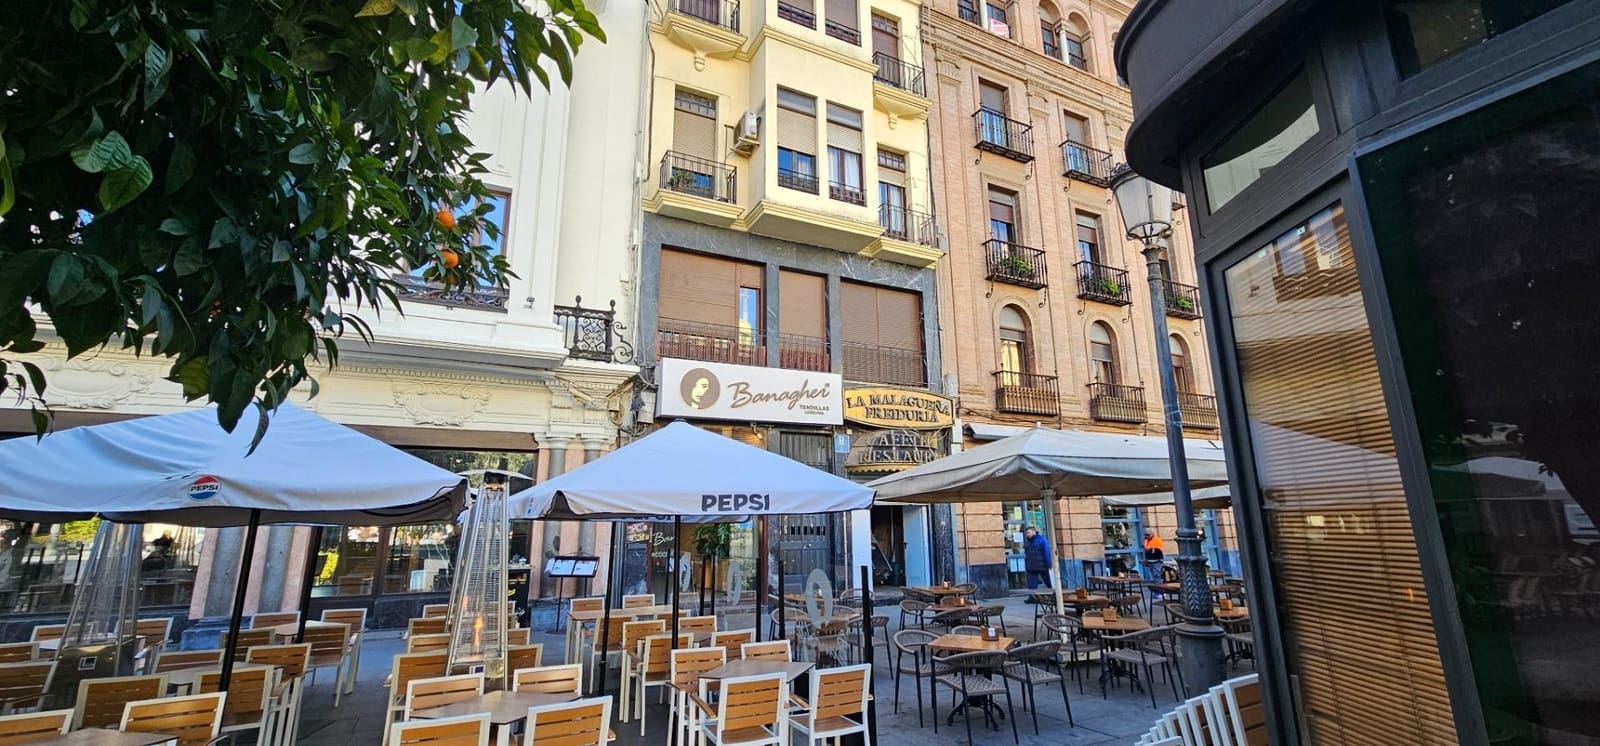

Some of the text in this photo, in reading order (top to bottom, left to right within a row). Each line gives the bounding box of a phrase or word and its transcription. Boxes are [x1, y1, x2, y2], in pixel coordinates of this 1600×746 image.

[728, 379, 829, 410] Banagher
[846, 396, 866, 408] LA
[191, 484, 219, 492] PEPSI
[701, 494, 770, 512] PEPSI
